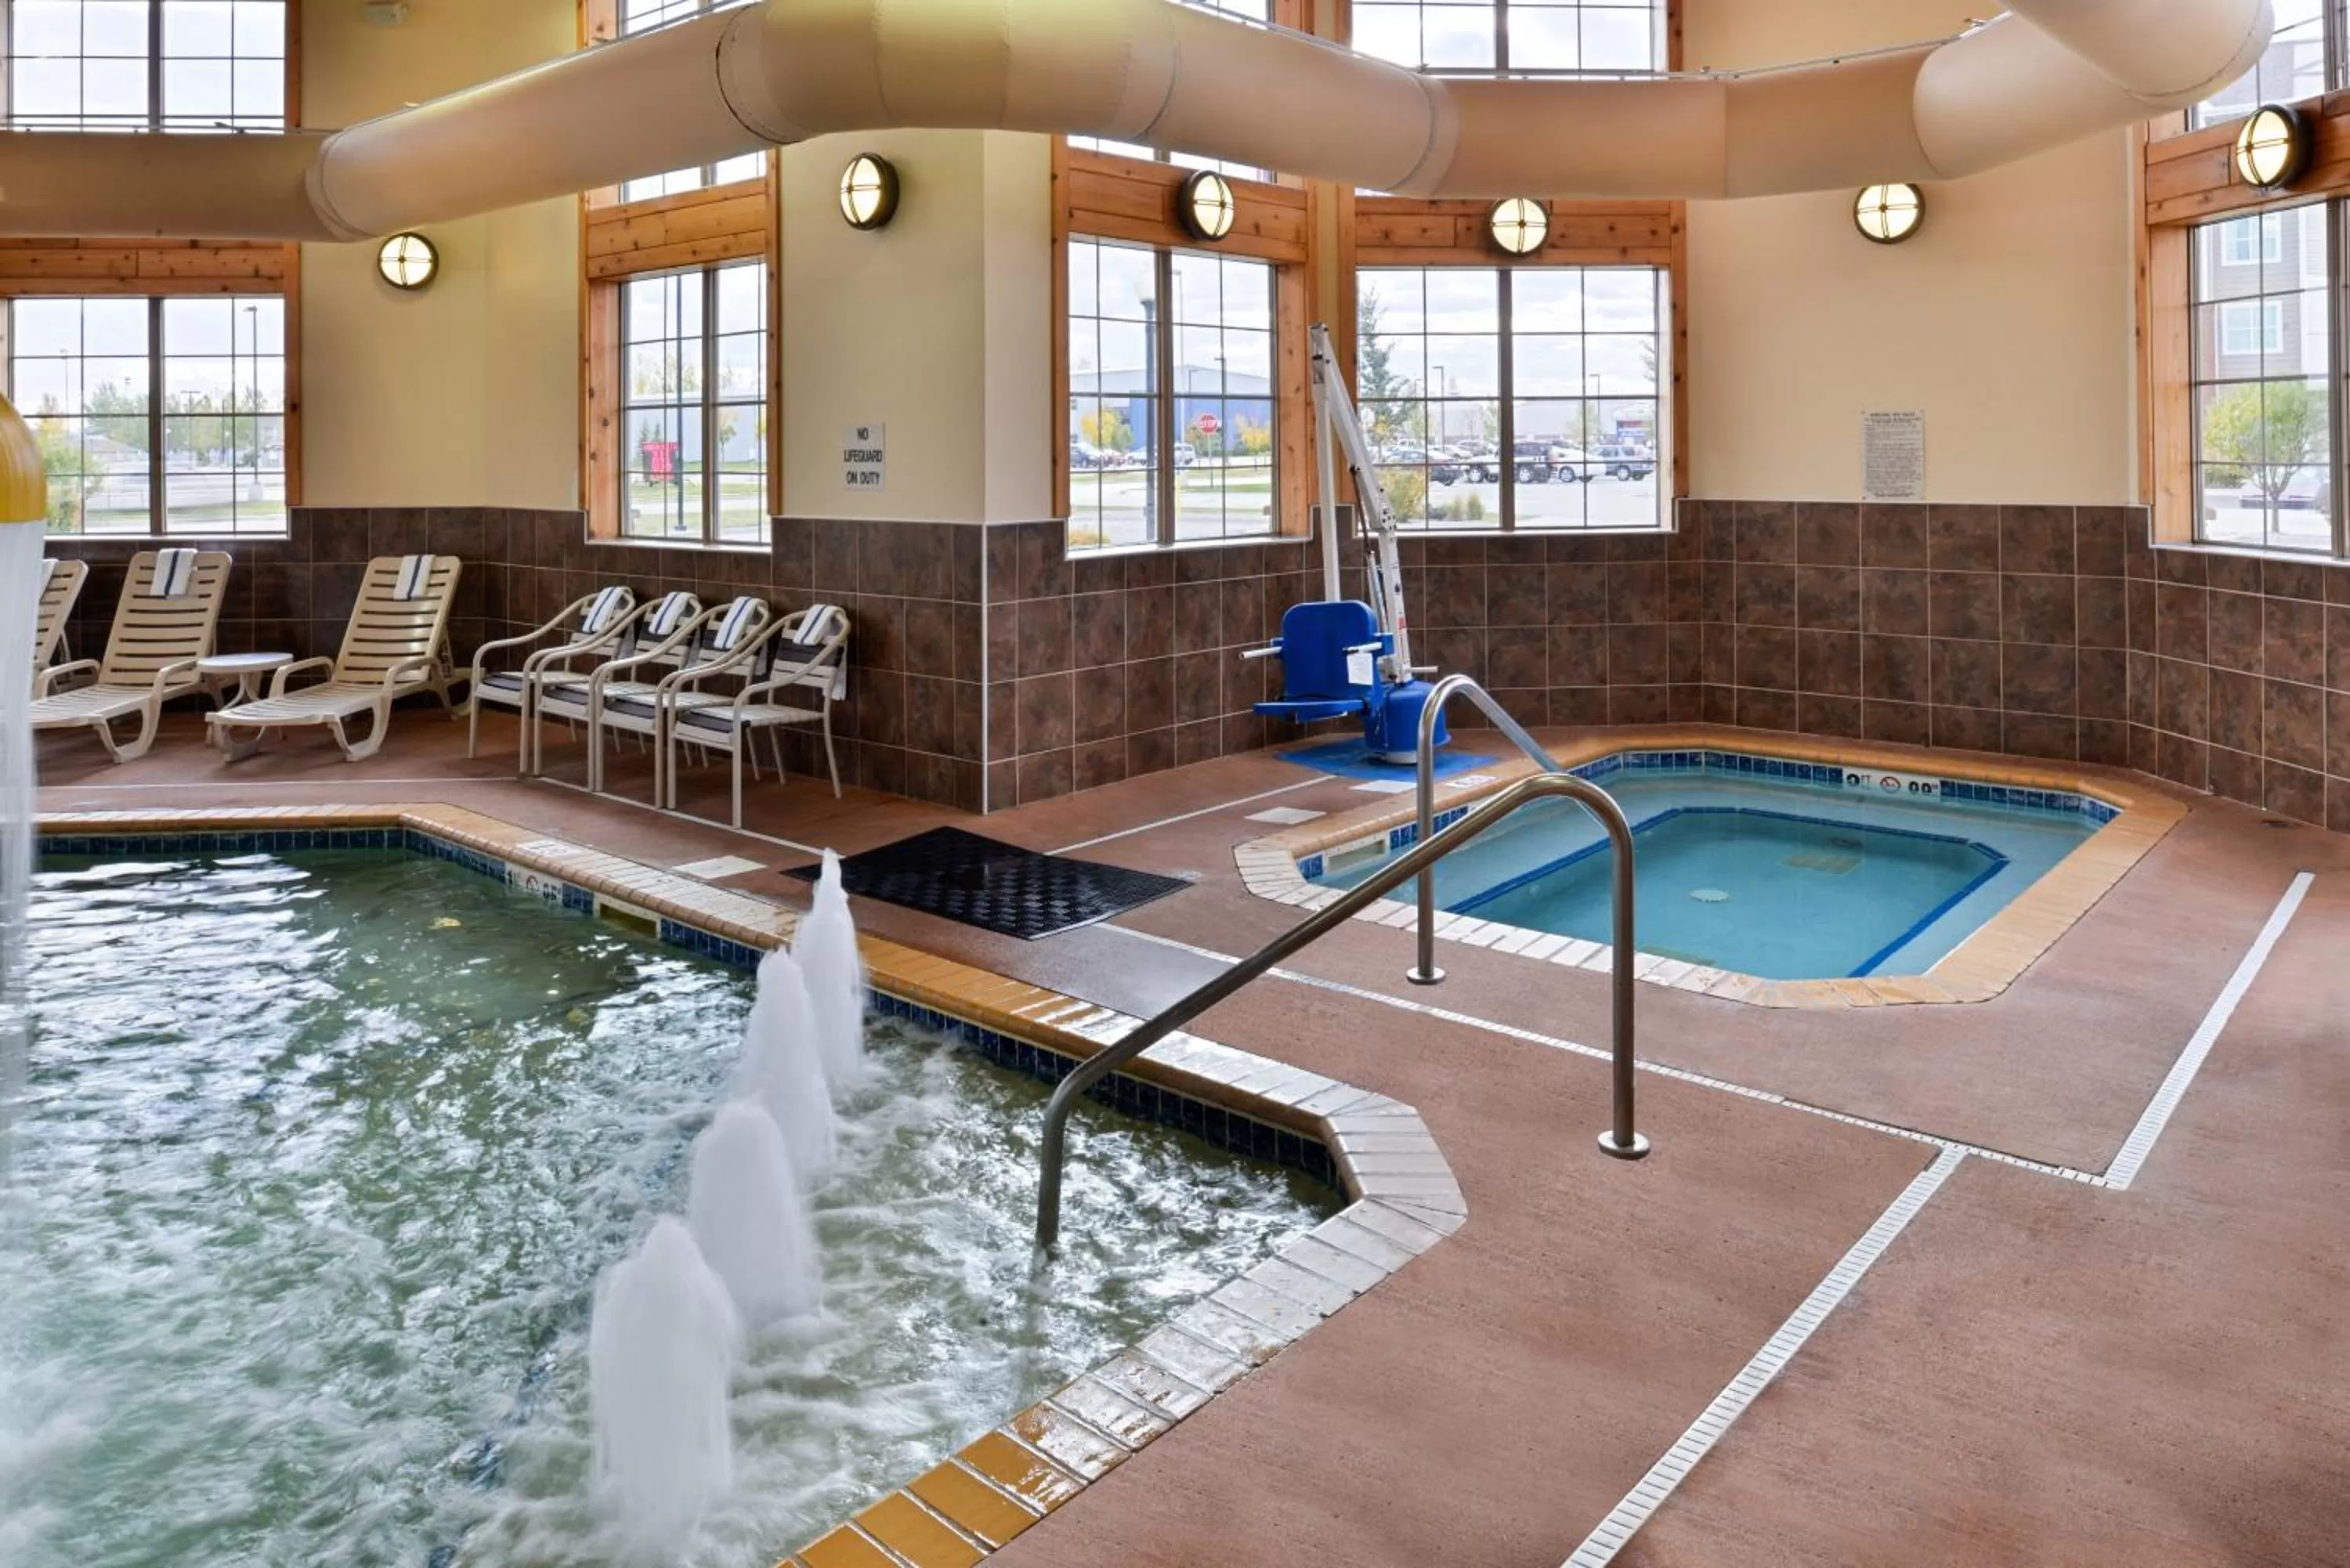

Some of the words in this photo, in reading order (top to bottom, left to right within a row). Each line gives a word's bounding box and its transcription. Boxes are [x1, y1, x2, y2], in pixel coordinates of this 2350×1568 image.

[857, 427, 869, 440] NO
[844, 449, 882, 463] LIFEGUARD
[847, 471, 858, 485] ON
[860, 471, 880, 485] DUTY
